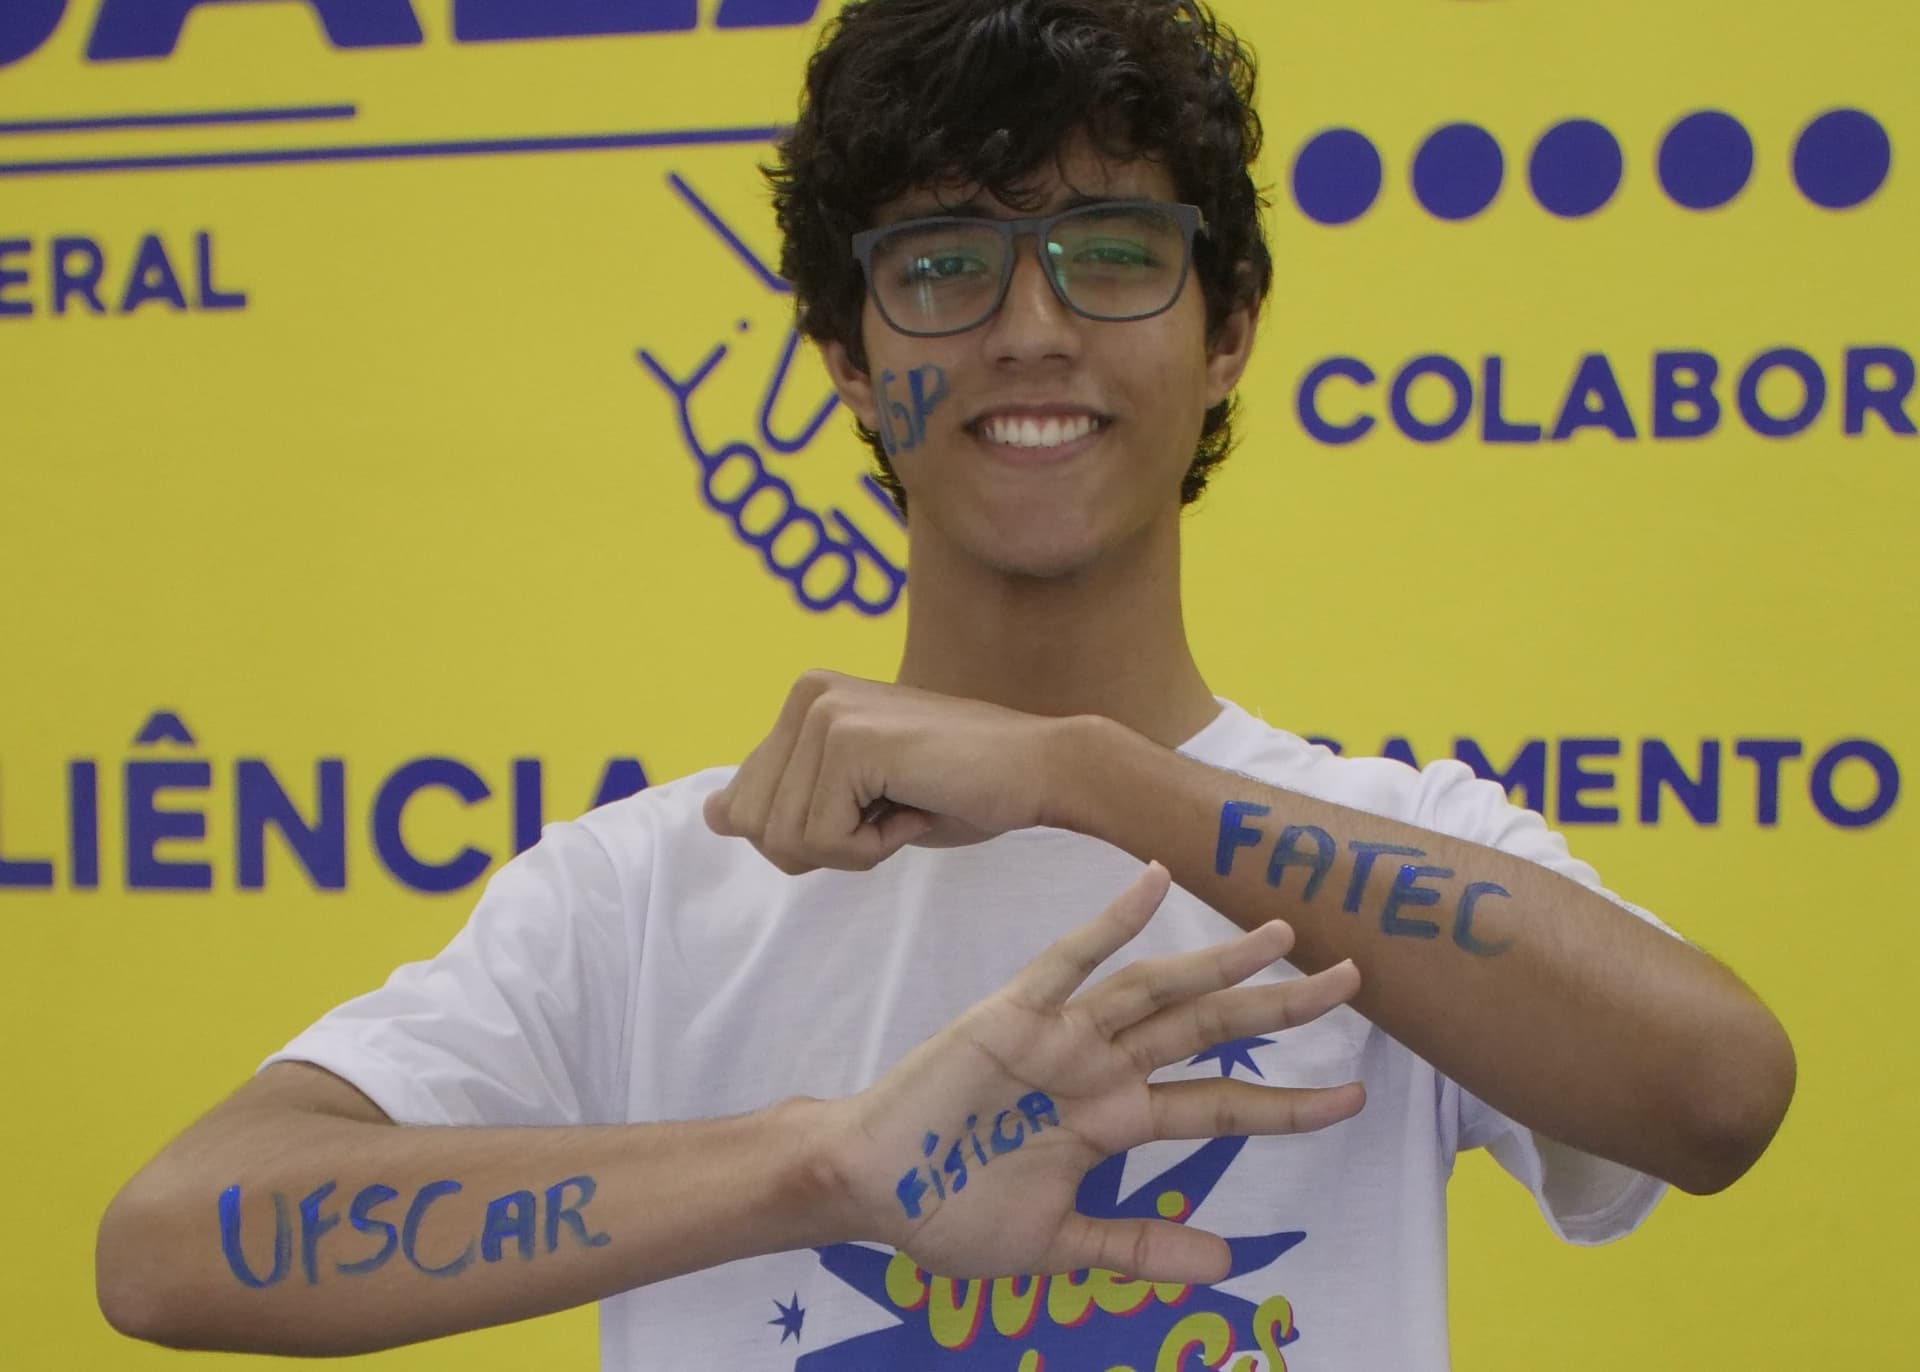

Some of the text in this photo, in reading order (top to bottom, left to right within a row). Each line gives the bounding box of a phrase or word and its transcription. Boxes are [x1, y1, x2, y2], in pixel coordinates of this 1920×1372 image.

[0, 232, 247, 315] ERAL
[1296, 346, 1920, 445] COLABOR
[1306, 735, 1901, 829] MENTO
[1214, 800, 1514, 957] FATEC
[218, 1174, 612, 1289] UFSCAR
